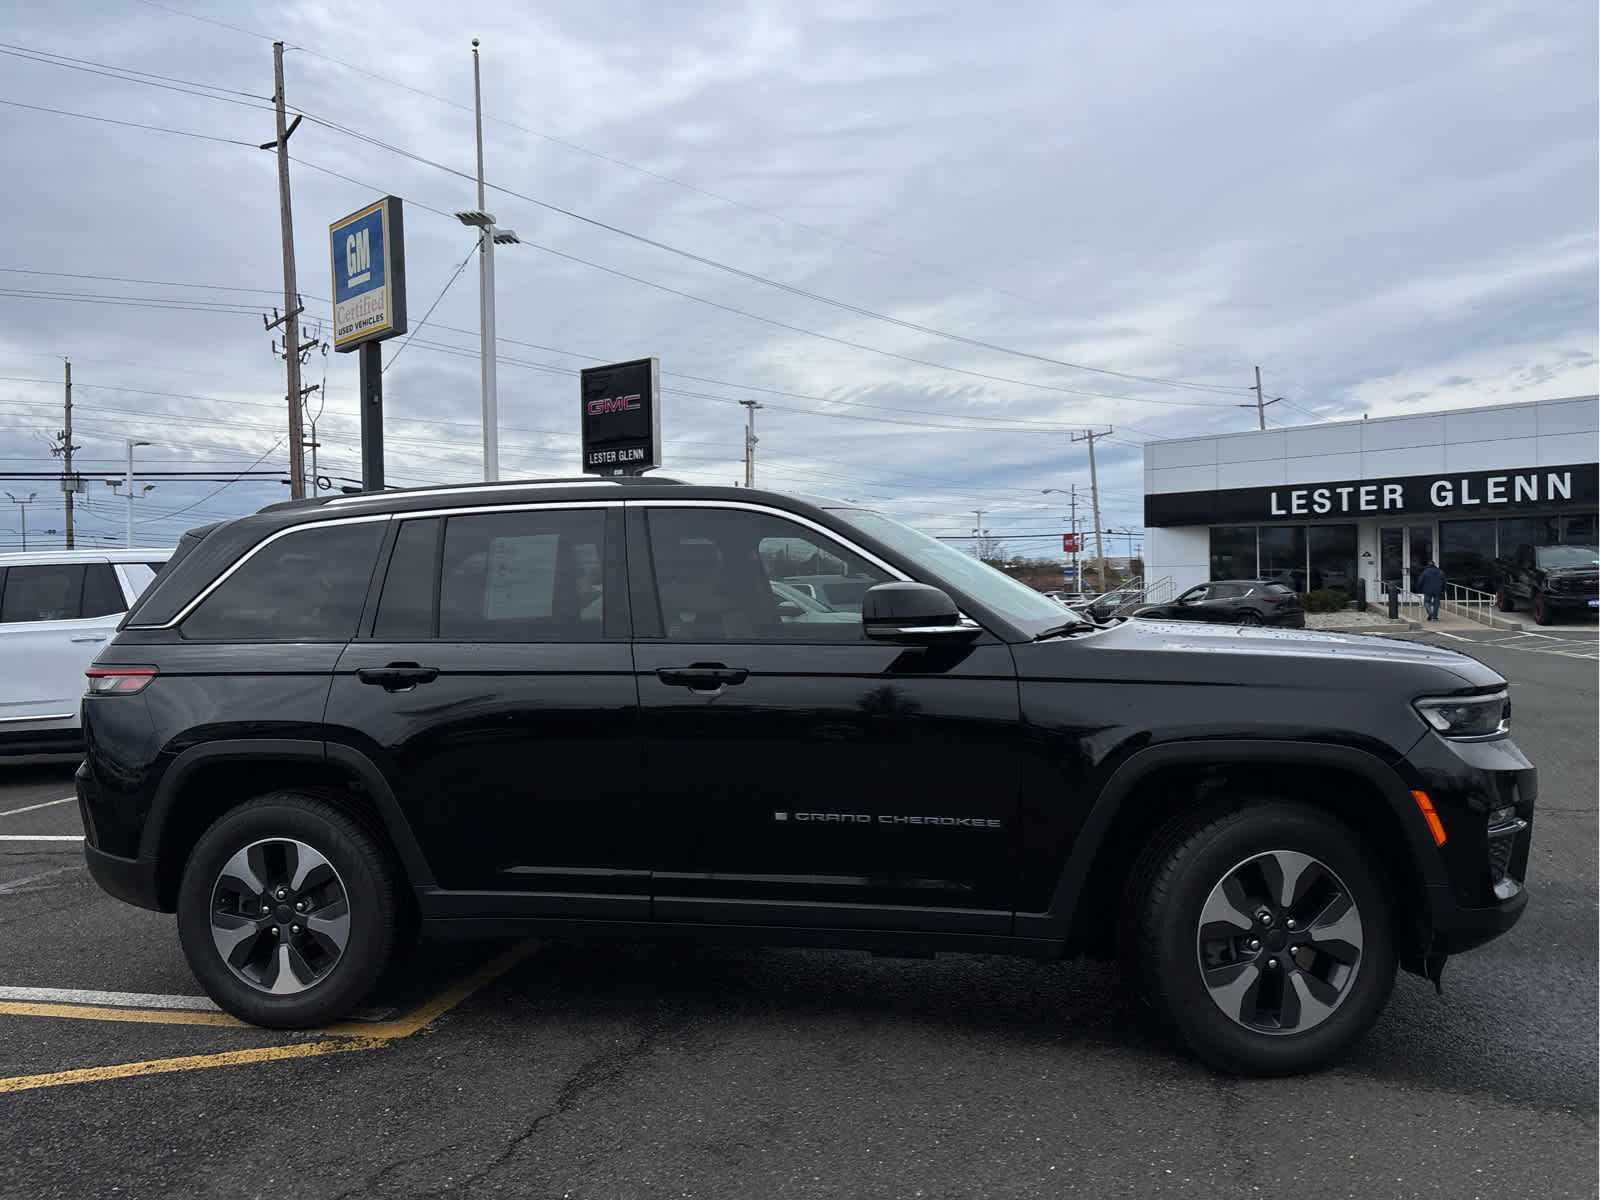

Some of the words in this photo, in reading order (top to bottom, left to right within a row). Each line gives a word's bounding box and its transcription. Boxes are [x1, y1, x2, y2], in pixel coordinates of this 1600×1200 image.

[346, 228, 370, 276] GM
[337, 291, 384, 324] Certified
[338, 324, 354, 336] USED
[354, 313, 384, 329] VEHICLES
[588, 394, 641, 415] GMC
[589, 451, 617, 464] LESTER
[618, 448, 644, 461] GLENN
[1270, 484, 1404, 515] LESTER
[1429, 472, 1572, 507] GLENN
[795, 812, 871, 823] GRAND
[878, 815, 1001, 828] CHEROKEE
